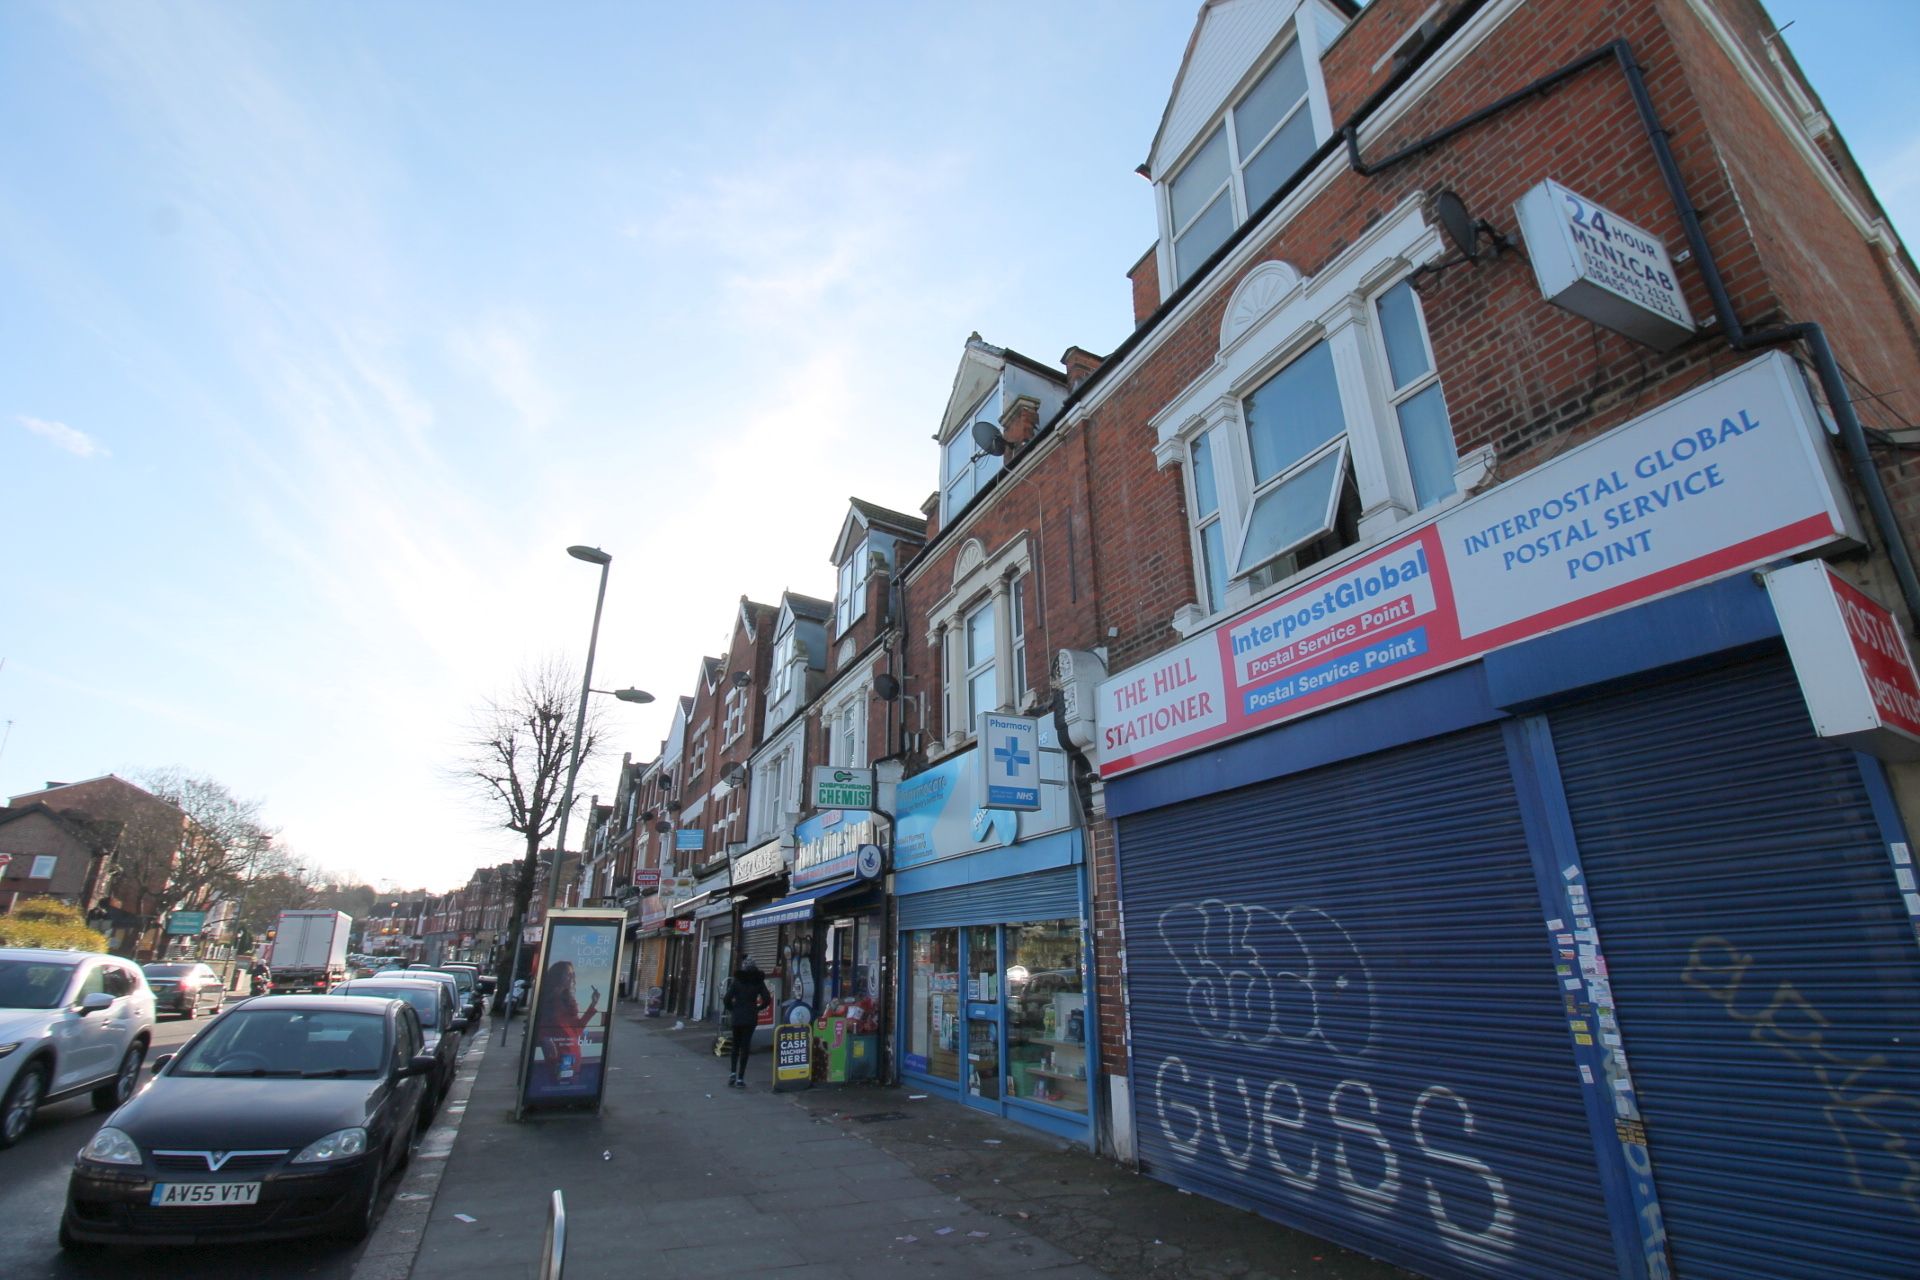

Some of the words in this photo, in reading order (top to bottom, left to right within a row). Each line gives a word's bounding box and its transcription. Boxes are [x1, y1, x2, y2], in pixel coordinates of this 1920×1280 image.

[1566, 195, 1611, 241] 24
[1612, 226, 1658, 260] HOUR
[1570, 224, 1674, 291] MINICAB
[1584, 252, 1609, 274] 020
[1463, 471, 1629, 556] INTERPOSTAL
[1634, 409, 1760, 479] GLOBAL
[1502, 519, 1598, 571] POSTAL
[1604, 463, 1725, 529] SERVICE
[1567, 529, 1652, 580] POINT
[1231, 548, 1429, 657] InterpostGlobal
[1252, 647, 1294, 676] Postal
[1298, 622, 1357, 656] Service
[1360, 599, 1410, 631] Point
[1836, 591, 1908, 667] POSTAL
[1250, 681, 1294, 710] Postal
[1299, 660, 1360, 692] Service
[1364, 637, 1417, 669] Point
[1113, 678, 1149, 713] THE
[1153, 657, 1197, 696] HILL
[990, 719, 1032, 733] Pharmacy
[1105, 692, 1213, 750] STATIONER
[819, 782, 871, 791] DISPENSING
[1016, 791, 1034, 801] NHS
[819, 789, 871, 806] CHEMIST
[571, 936, 609, 944] NEER
[577, 945, 609, 956] LOOK
[578, 1035, 593, 1046] blu
[780, 1032, 806, 1041] FREE
[780, 1040, 807, 1049] CASH
[780, 1048, 806, 1056] MACHINE
[780, 1055, 807, 1064] HERE
[165, 1185, 216, 1201] AV55
[221, 1184, 257, 1201] VTY
